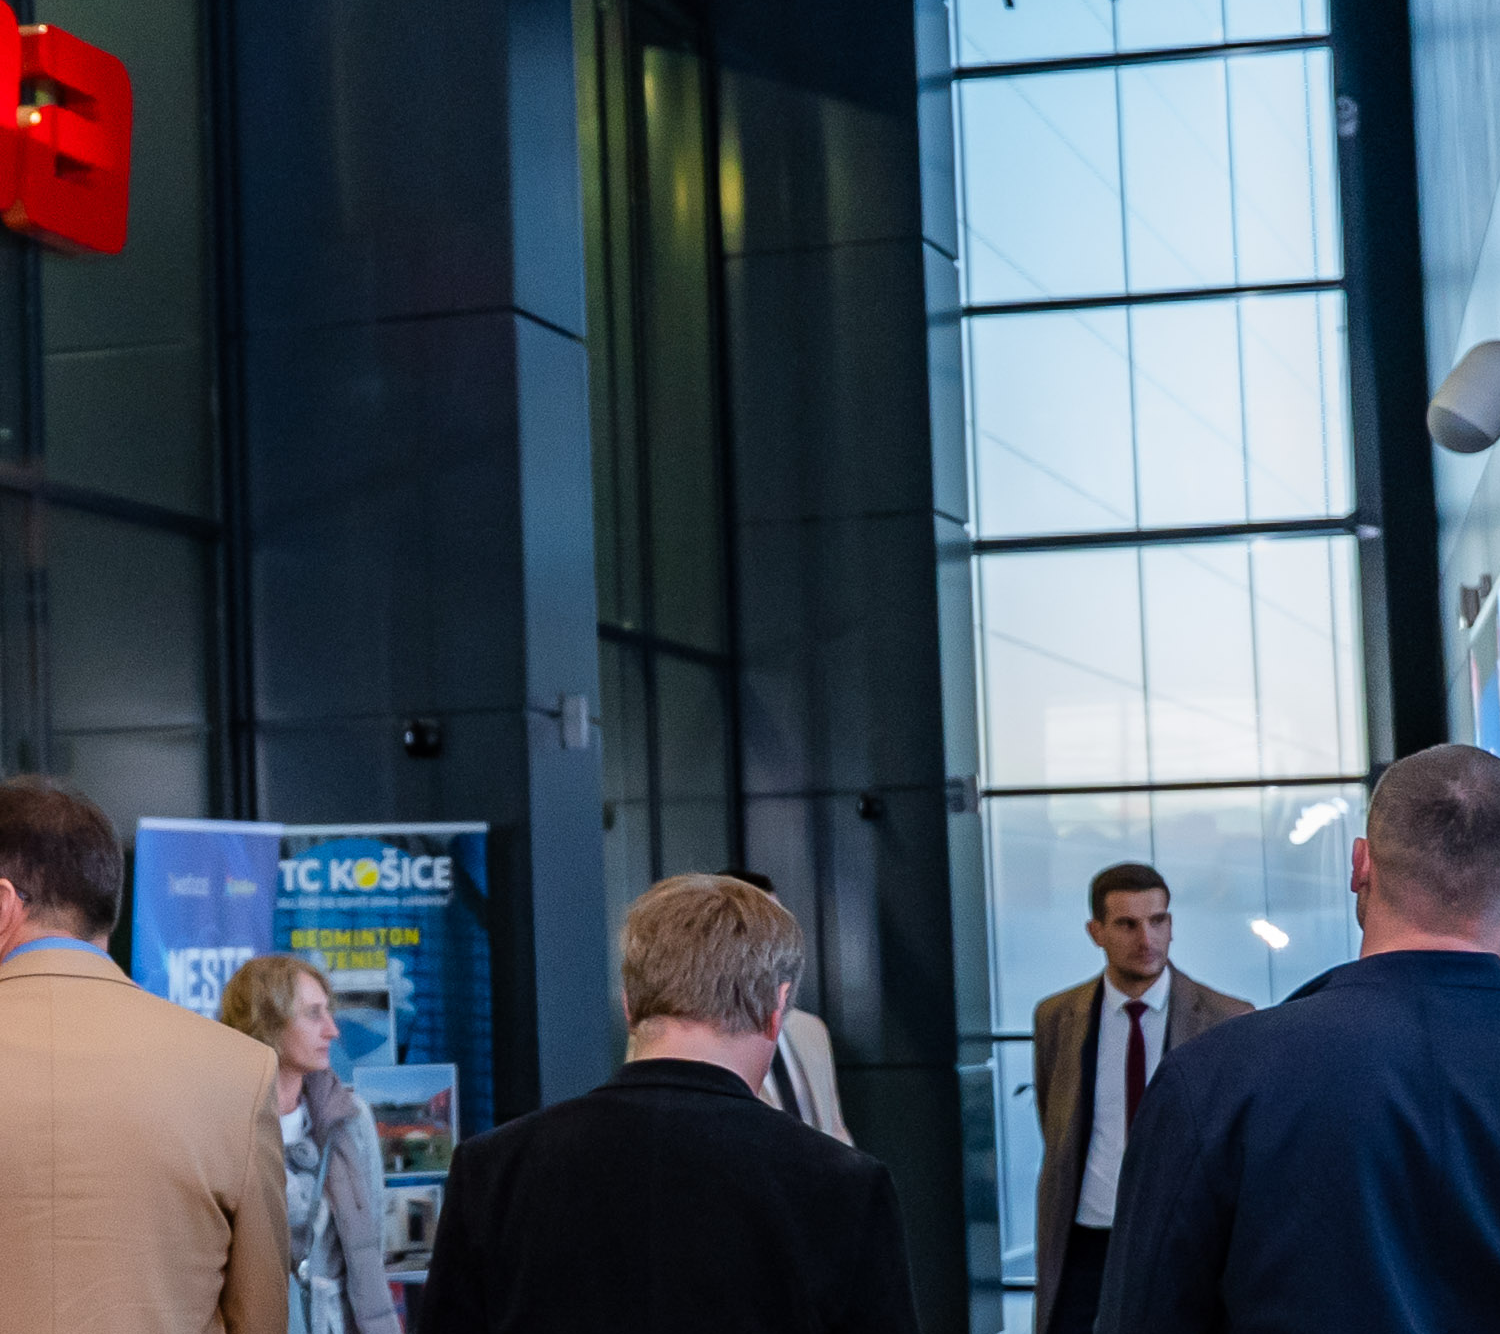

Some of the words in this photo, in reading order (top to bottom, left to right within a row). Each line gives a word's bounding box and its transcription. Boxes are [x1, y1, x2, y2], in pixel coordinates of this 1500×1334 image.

[279, 858, 321, 892] TC
[329, 848, 453, 892] KOŠICE
[291, 927, 420, 949] BEDMINTON
[324, 950, 387, 970] TENIS
